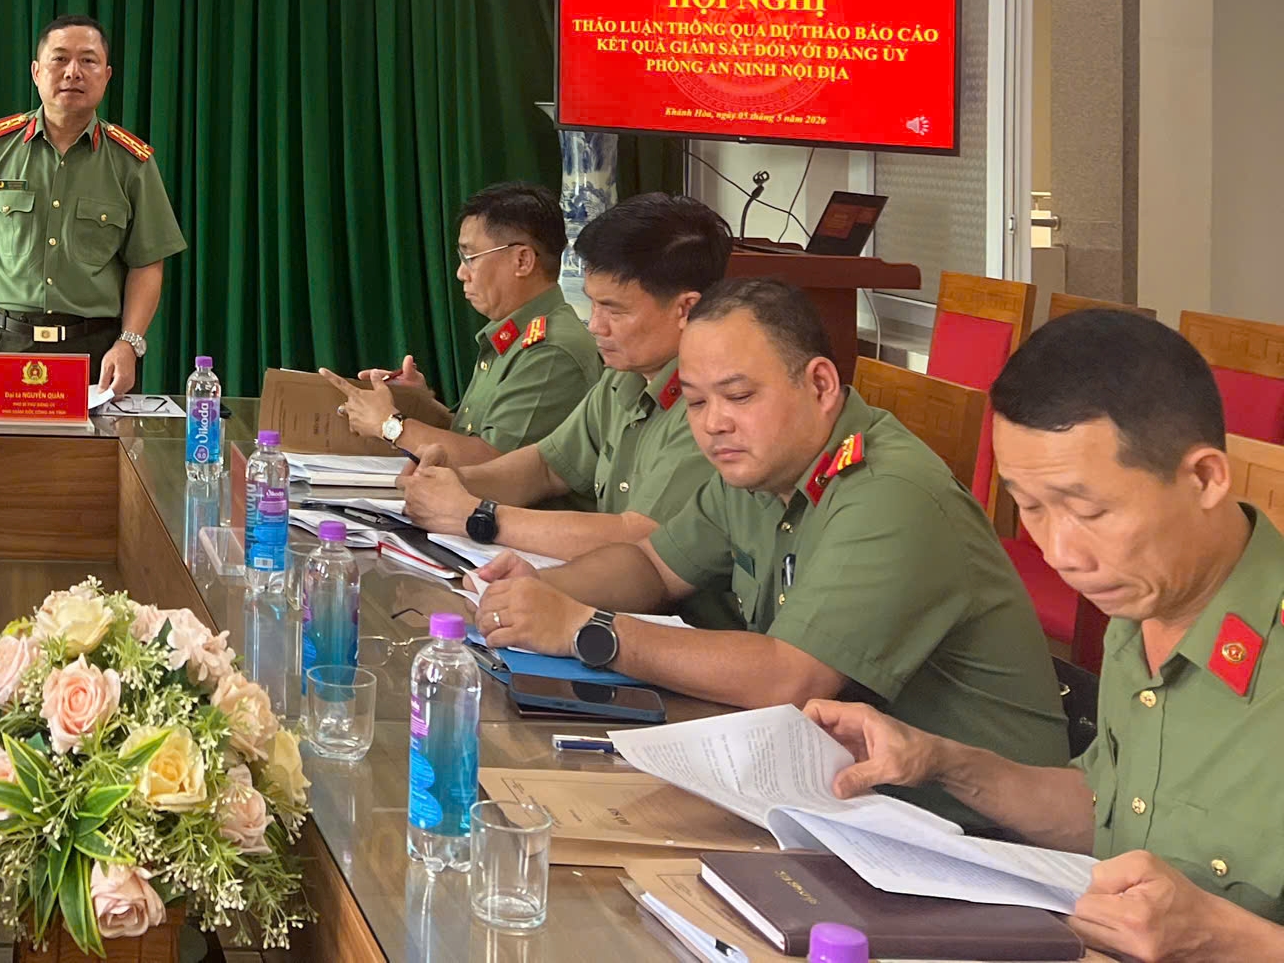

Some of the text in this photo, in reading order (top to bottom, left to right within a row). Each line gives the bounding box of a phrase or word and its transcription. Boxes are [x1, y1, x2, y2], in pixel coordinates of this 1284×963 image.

[572, 17, 939, 43] THẢO LUẬN THÔNG QUA DỰ THẢO BÁO CÁO
[597, 35, 909, 62] KẾT QUẢ GIÁM SÁT ĐỐI VỚI ĐẢNG ỦY
[646, 56, 849, 82] PHÒNG AN NINH NỘI ĐỊA
[665, 107, 692, 117] Khánh
[716, 111, 735, 121] ngày
[750, 112, 774, 123] tháng
[784, 114, 803, 123] năm
[805, 115, 827, 125] 2026
[195, 402, 209, 444] Vikoda
